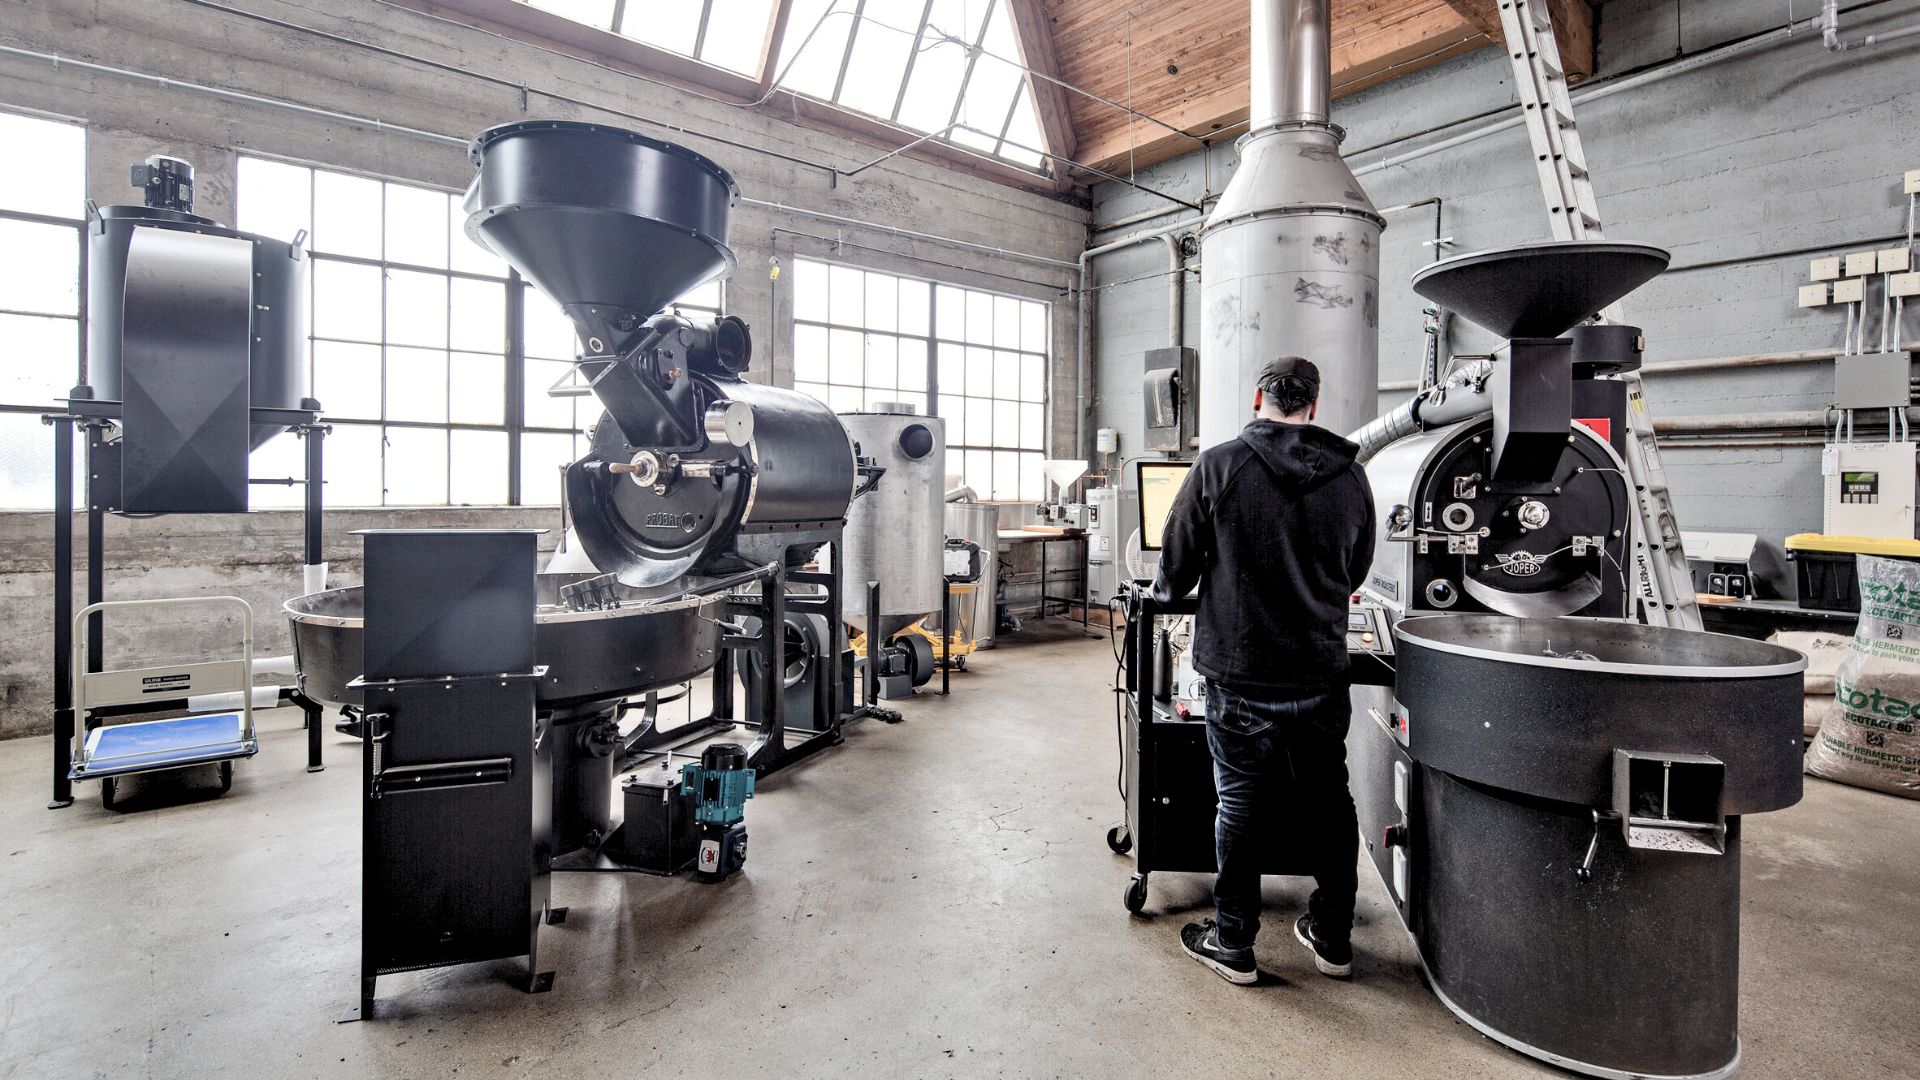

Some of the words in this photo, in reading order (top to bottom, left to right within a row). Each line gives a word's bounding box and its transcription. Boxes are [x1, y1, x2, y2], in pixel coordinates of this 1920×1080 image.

[647, 512, 681, 525] PROBAT
[1509, 562, 1535, 574] JOPER
[1845, 711, 1893, 729] ECOTACT
[1897, 722, 1913, 733] 80
[1854, 745, 1902, 762] HERMETIC
